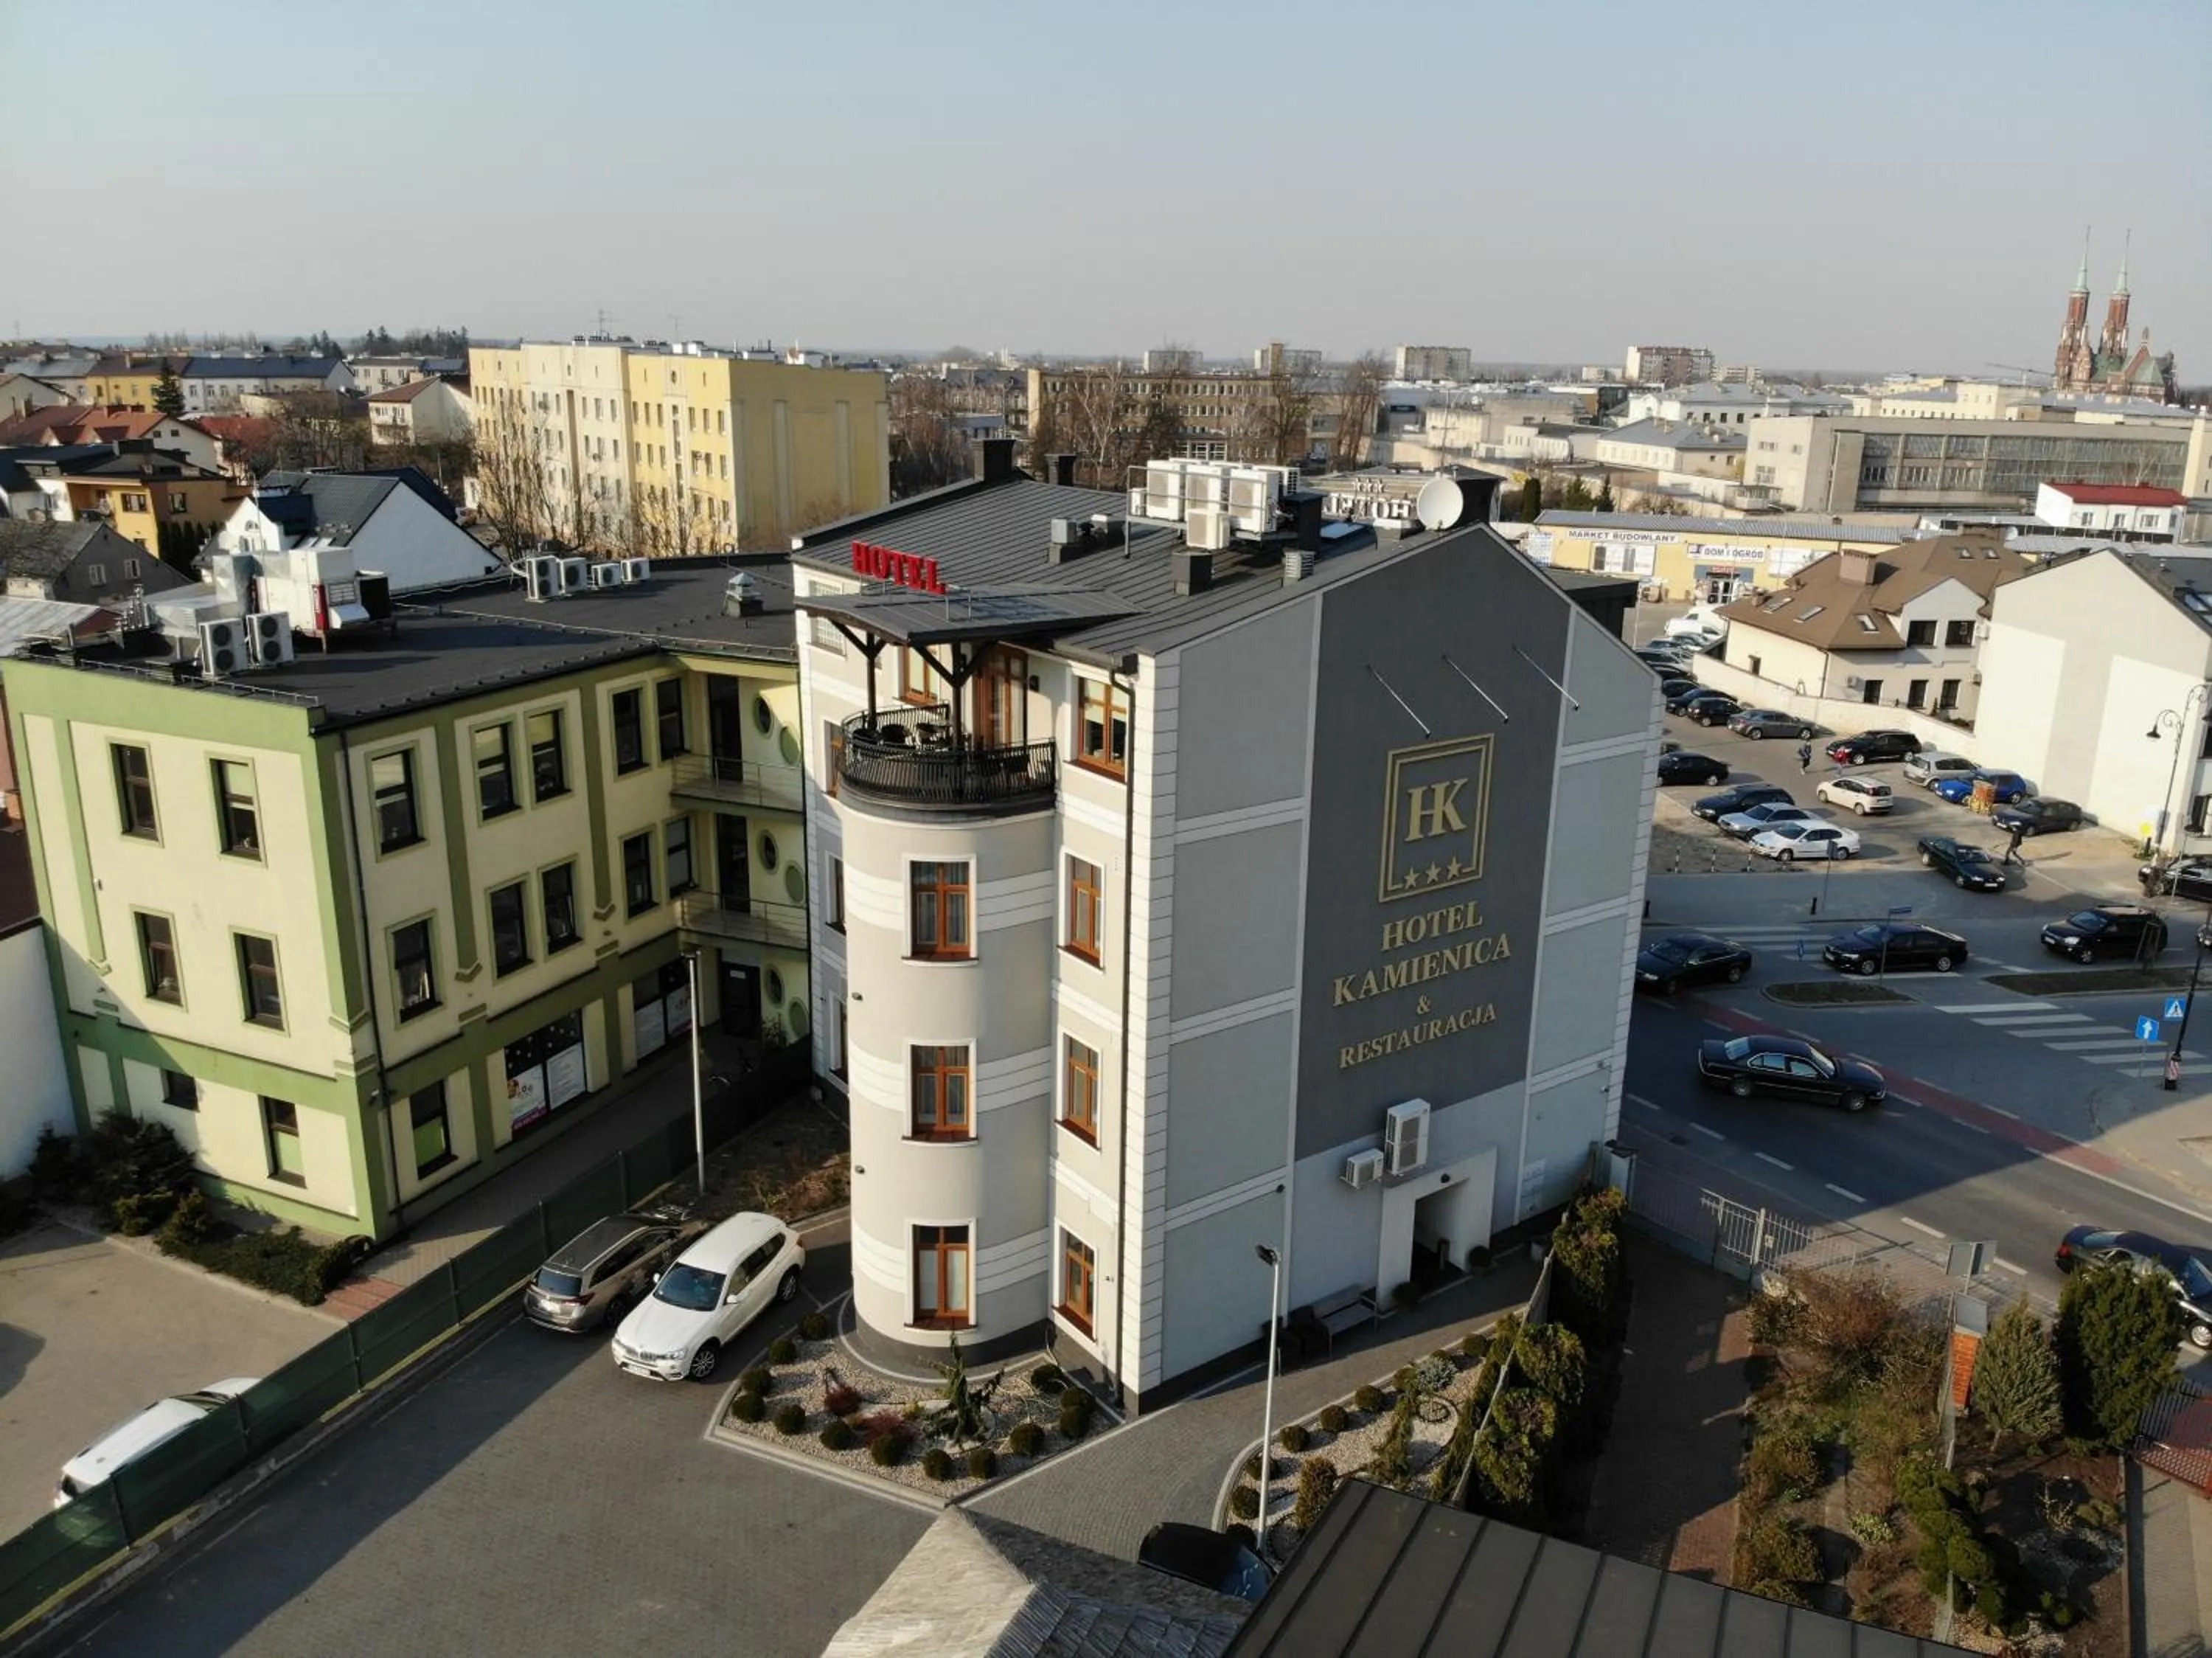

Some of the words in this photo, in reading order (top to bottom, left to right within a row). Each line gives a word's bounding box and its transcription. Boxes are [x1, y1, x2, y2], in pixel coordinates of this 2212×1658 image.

[1568, 530, 1610, 539] MARKET
[1704, 548, 1725, 556] DOM
[852, 540, 947, 595] HOTEL
[1405, 777, 1468, 842] HK
[1381, 901, 1484, 951] HOTEL
[1332, 932, 1512, 1007] KAMIENICA
[1416, 994, 1432, 1015] &
[1338, 1002, 1497, 1069] RESTAURACJA
